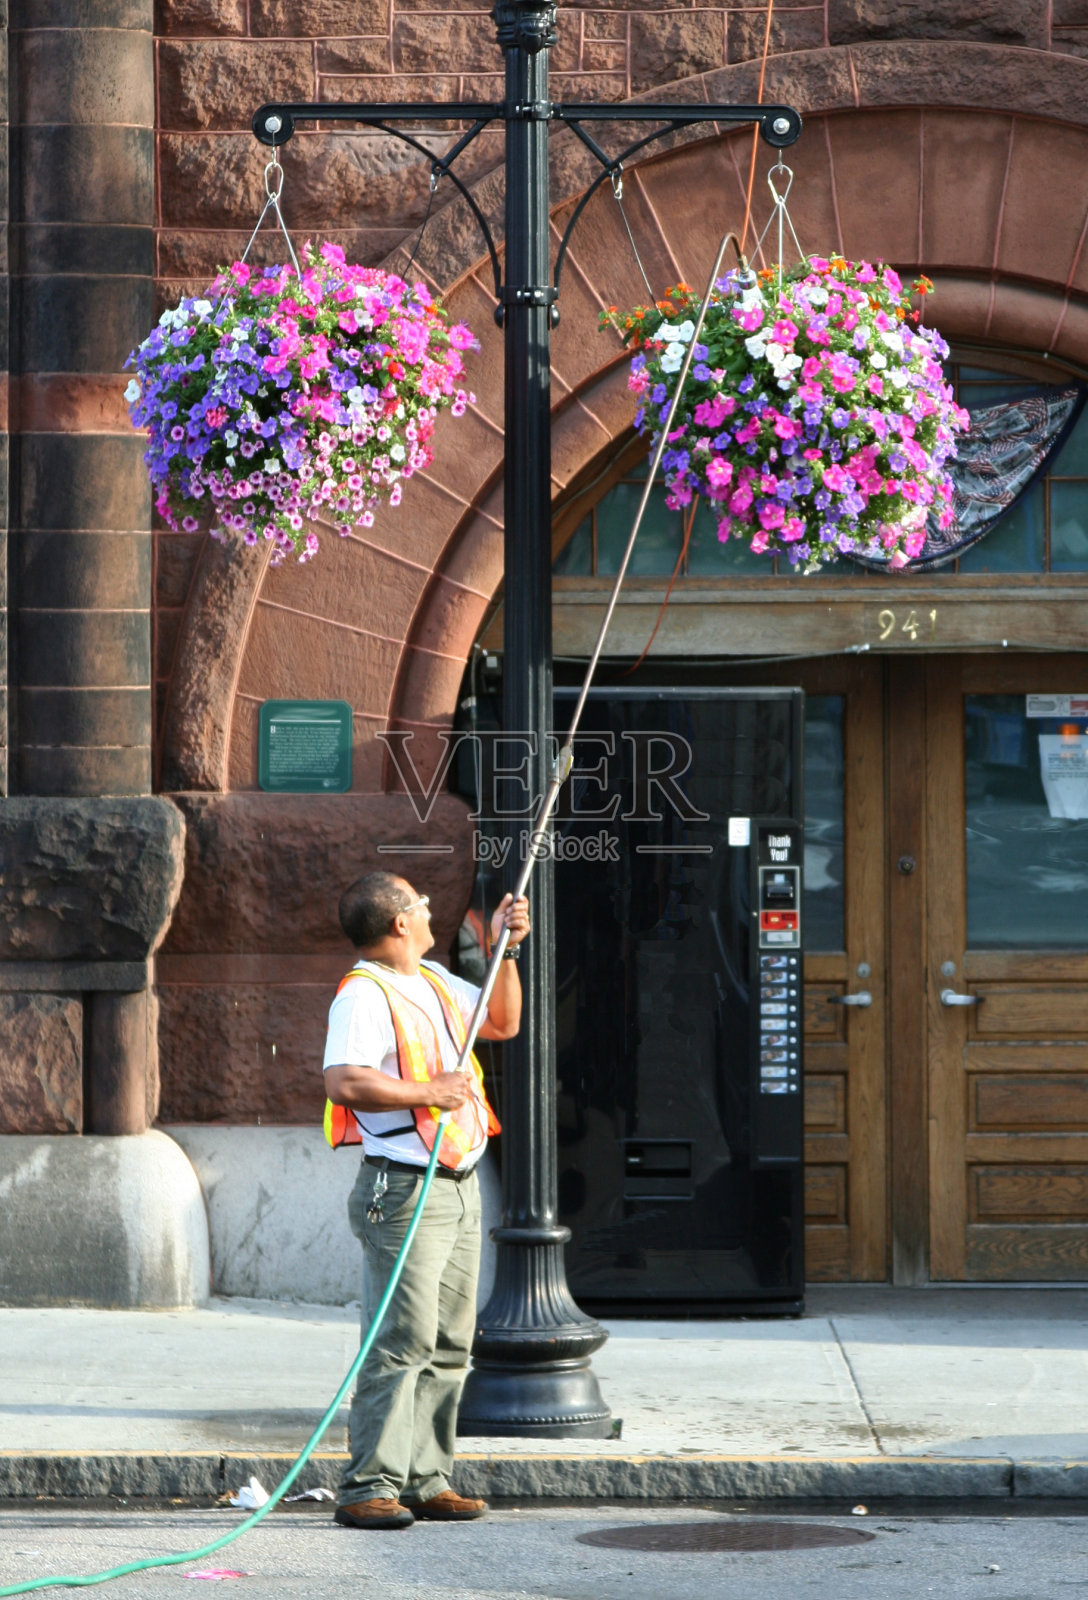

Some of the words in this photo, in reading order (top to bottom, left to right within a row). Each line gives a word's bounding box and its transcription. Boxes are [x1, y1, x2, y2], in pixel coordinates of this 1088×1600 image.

[878, 608, 937, 641] 941
[768, 835, 791, 847] Thank
[771, 848, 788, 861] You!
